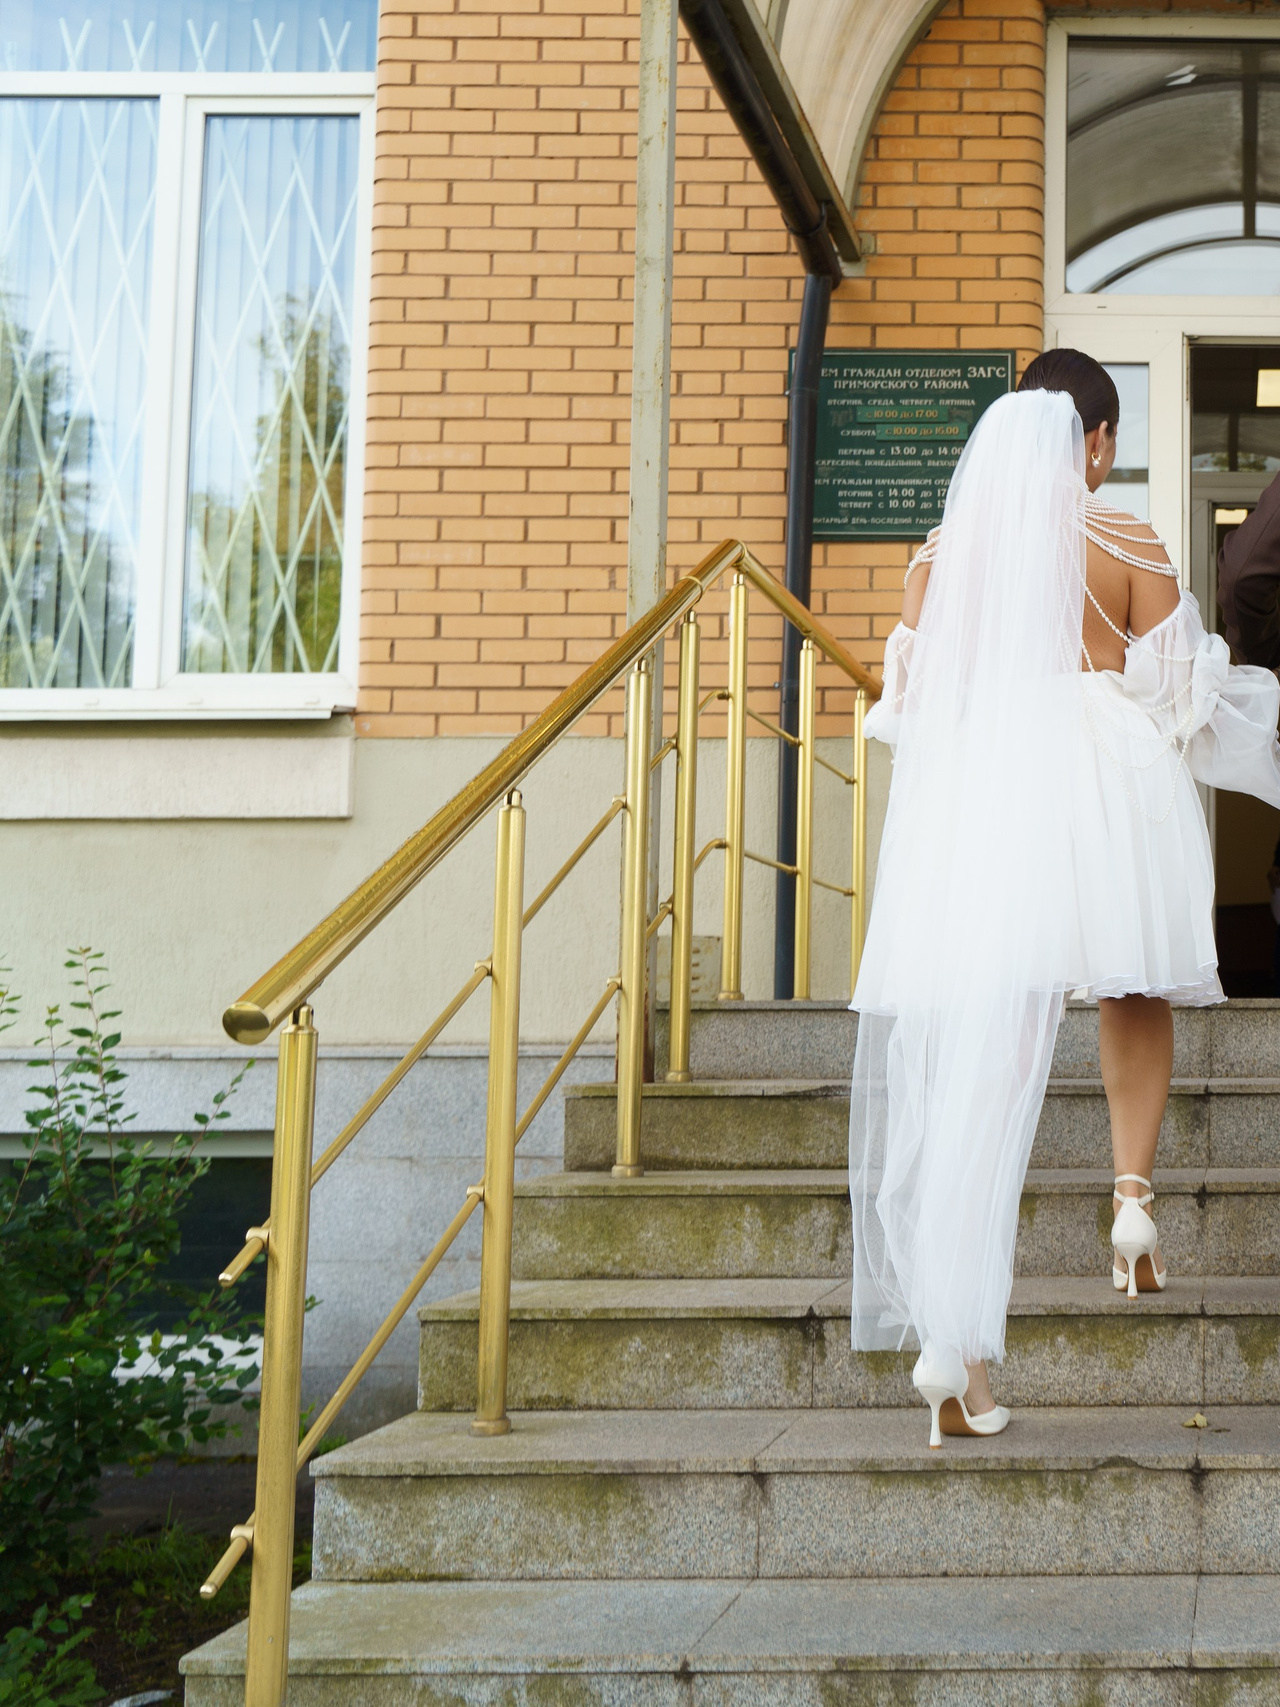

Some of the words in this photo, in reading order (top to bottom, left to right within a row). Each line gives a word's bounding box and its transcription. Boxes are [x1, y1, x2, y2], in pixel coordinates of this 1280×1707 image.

[843, 368, 901, 379] ГРАЖДАН
[905, 368, 961, 379] ОТДЕЛОМ
[967, 366, 1006, 379] ЗАГС
[834, 380, 918, 390] ПРИМОРСКОГО
[924, 379, 970, 390] РАЙОНА
[939, 398, 976, 407] ПЯТНИЦА
[840, 429, 876, 437] СУББОТА
[838, 448, 876, 456] ПЕРЕРЫВ
[890, 446, 916, 456] 13.00
[832, 478, 873, 486] ГРАЖДАН
[875, 478, 932, 486] НАЧАЛЬНИКОМ
[934, 478, 951, 486] ОТД
[838, 490, 873, 498] ВТОРНИК
[888, 488, 915, 497] 14.00
[838, 501, 873, 509] ЧЕТВЕРГ
[889, 499, 916, 509] 10.00
